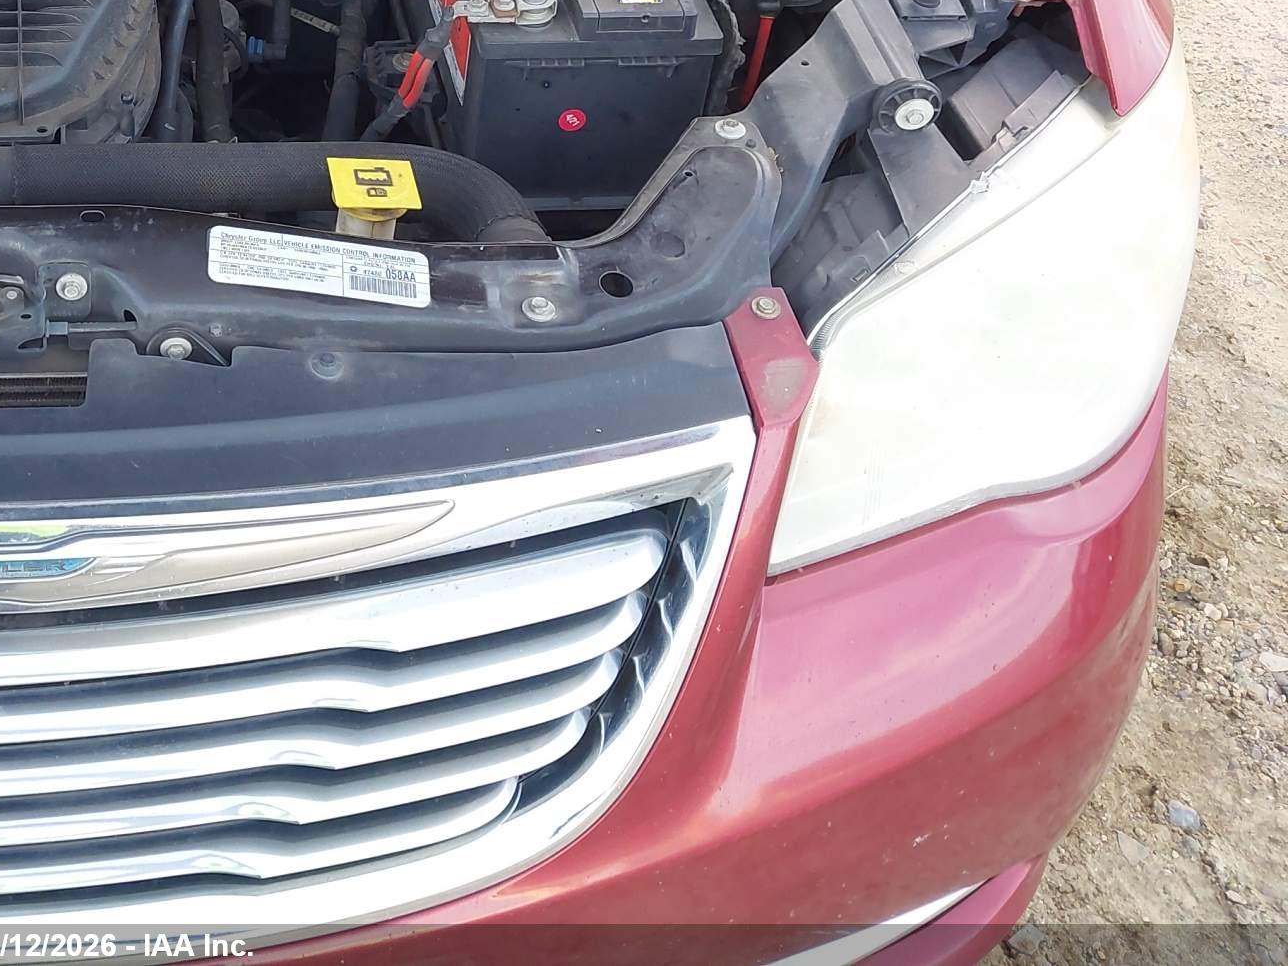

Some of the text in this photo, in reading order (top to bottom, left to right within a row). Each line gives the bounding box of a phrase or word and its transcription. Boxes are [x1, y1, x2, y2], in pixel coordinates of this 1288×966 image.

[284, 239, 309, 249] VEHICLE
[310, 243, 341, 253] EMISSION
[342, 247, 370, 258] CONTROL
[372, 251, 416, 264] INFORMATION
